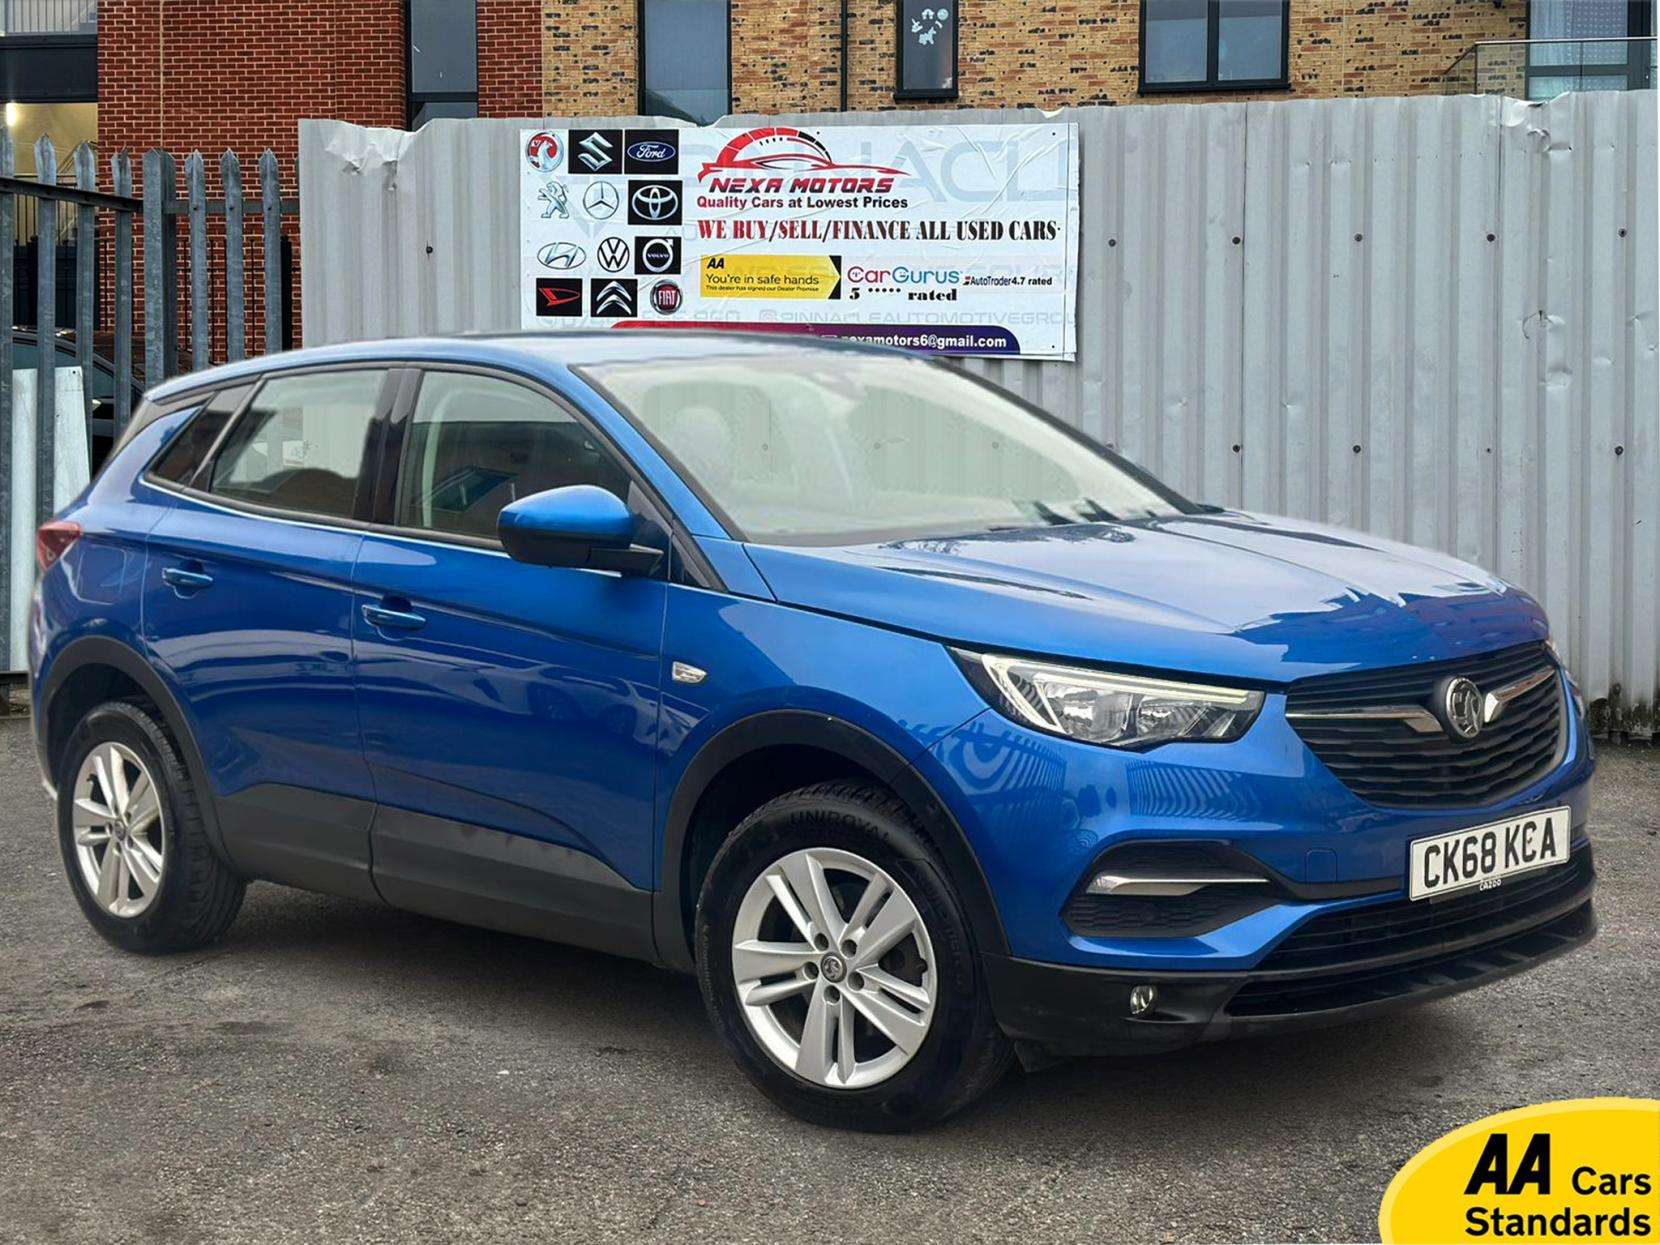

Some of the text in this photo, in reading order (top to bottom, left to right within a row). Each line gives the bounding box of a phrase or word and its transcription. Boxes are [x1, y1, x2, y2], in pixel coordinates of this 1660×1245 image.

[636, 144, 666, 158] Ford
[709, 177, 895, 193] NEXA MOTORS
[697, 196, 908, 210] Quality Cars at Lowest Prices
[697, 220, 727, 240] WE
[916, 220, 951, 241] ALL
[956, 220, 1004, 241] USED
[1008, 220, 1057, 241] CARS
[706, 257, 725, 269] AA
[705, 274, 820, 285] You're in safe hands
[847, 266, 960, 284] CarGurus
[1028, 277, 1053, 286] rated
[658, 290, 677, 306] FIAT
[849, 287, 958, 301] 5 rated
[1423, 817, 1557, 889] CK68 KCA
